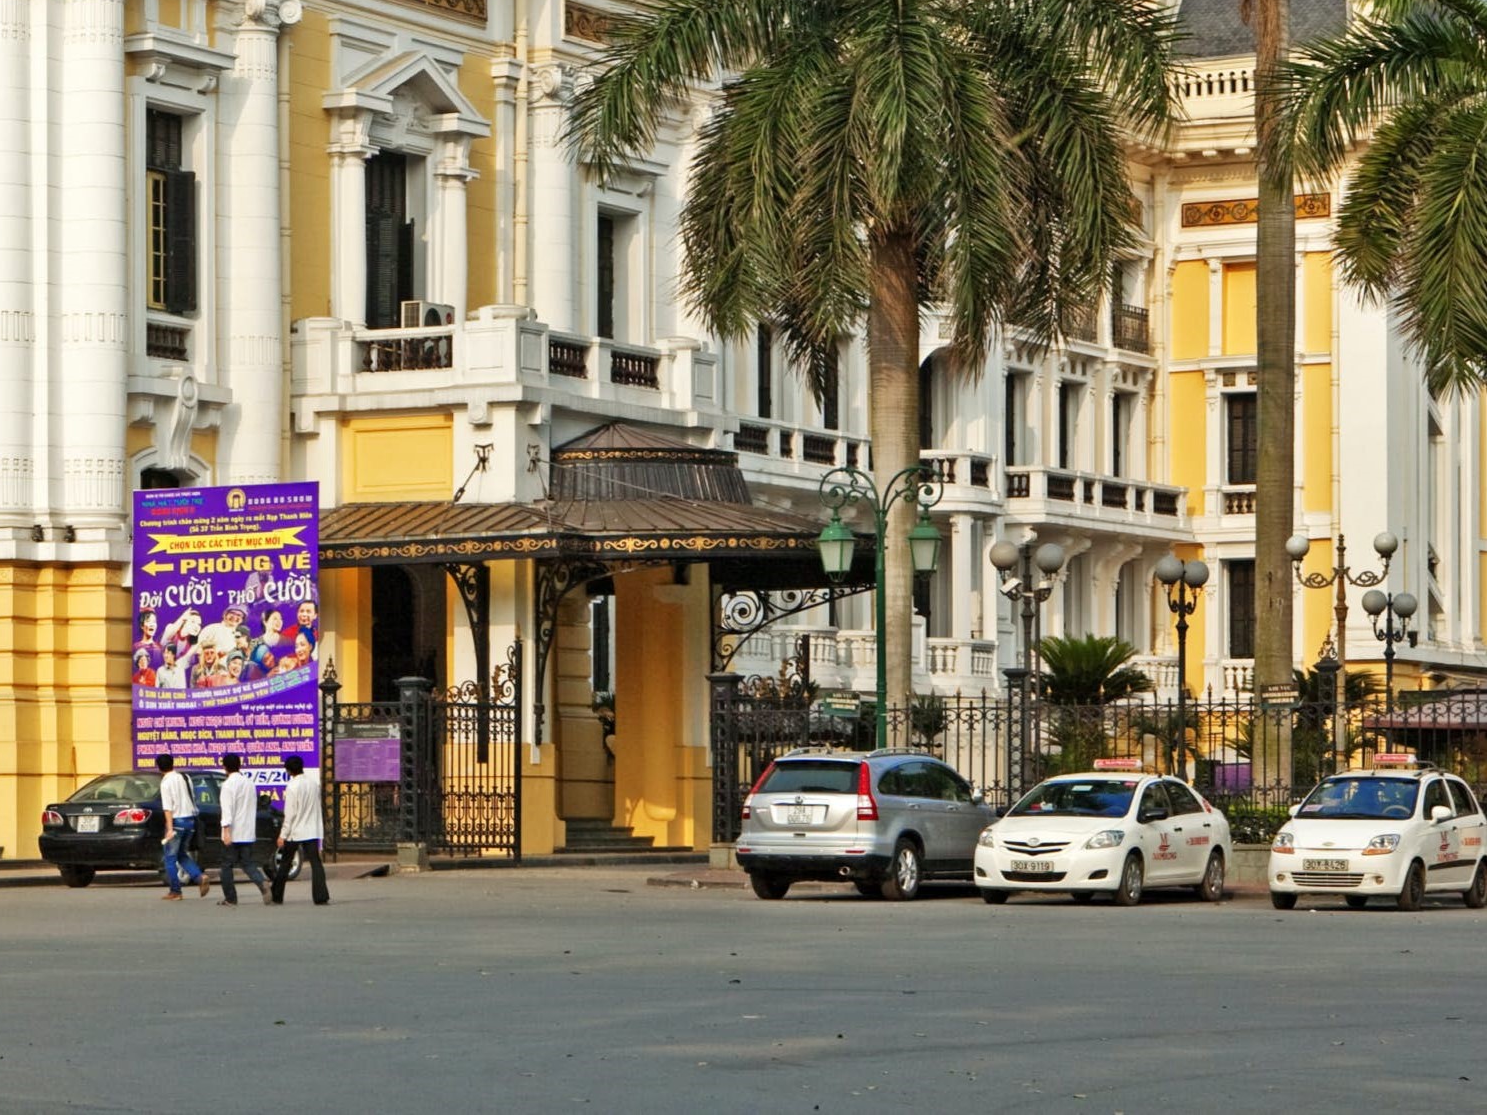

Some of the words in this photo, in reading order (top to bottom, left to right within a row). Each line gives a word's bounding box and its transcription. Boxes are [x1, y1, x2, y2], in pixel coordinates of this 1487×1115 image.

[169, 541, 190, 550] CHỌN
[193, 540, 206, 549] LỌC
[246, 538, 262, 548] MỤC
[180, 554, 272, 574] PHÒNG
[279, 551, 311, 570] VÉ
